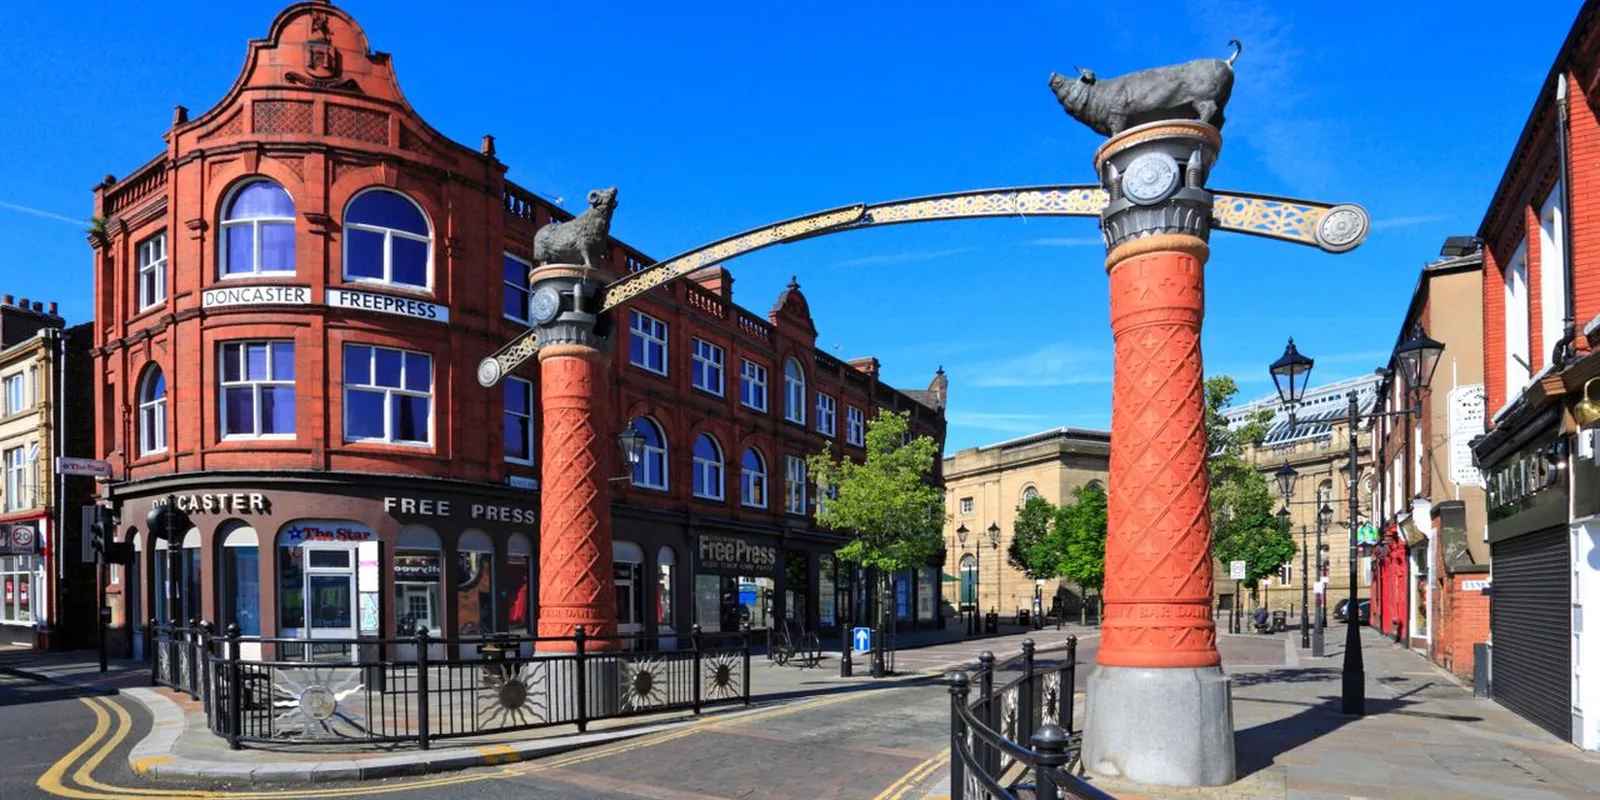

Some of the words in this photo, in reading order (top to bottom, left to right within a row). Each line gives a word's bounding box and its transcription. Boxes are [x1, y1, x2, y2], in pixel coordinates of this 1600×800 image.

[205, 287, 305, 306] DONCASTER
[339, 291, 437, 318] FREEPRESS
[384, 497, 450, 516] FREE
[471, 504, 535, 525] PRESS
[15, 532, 29, 541] 20
[302, 527, 334, 541] The
[335, 527, 371, 541] Star
